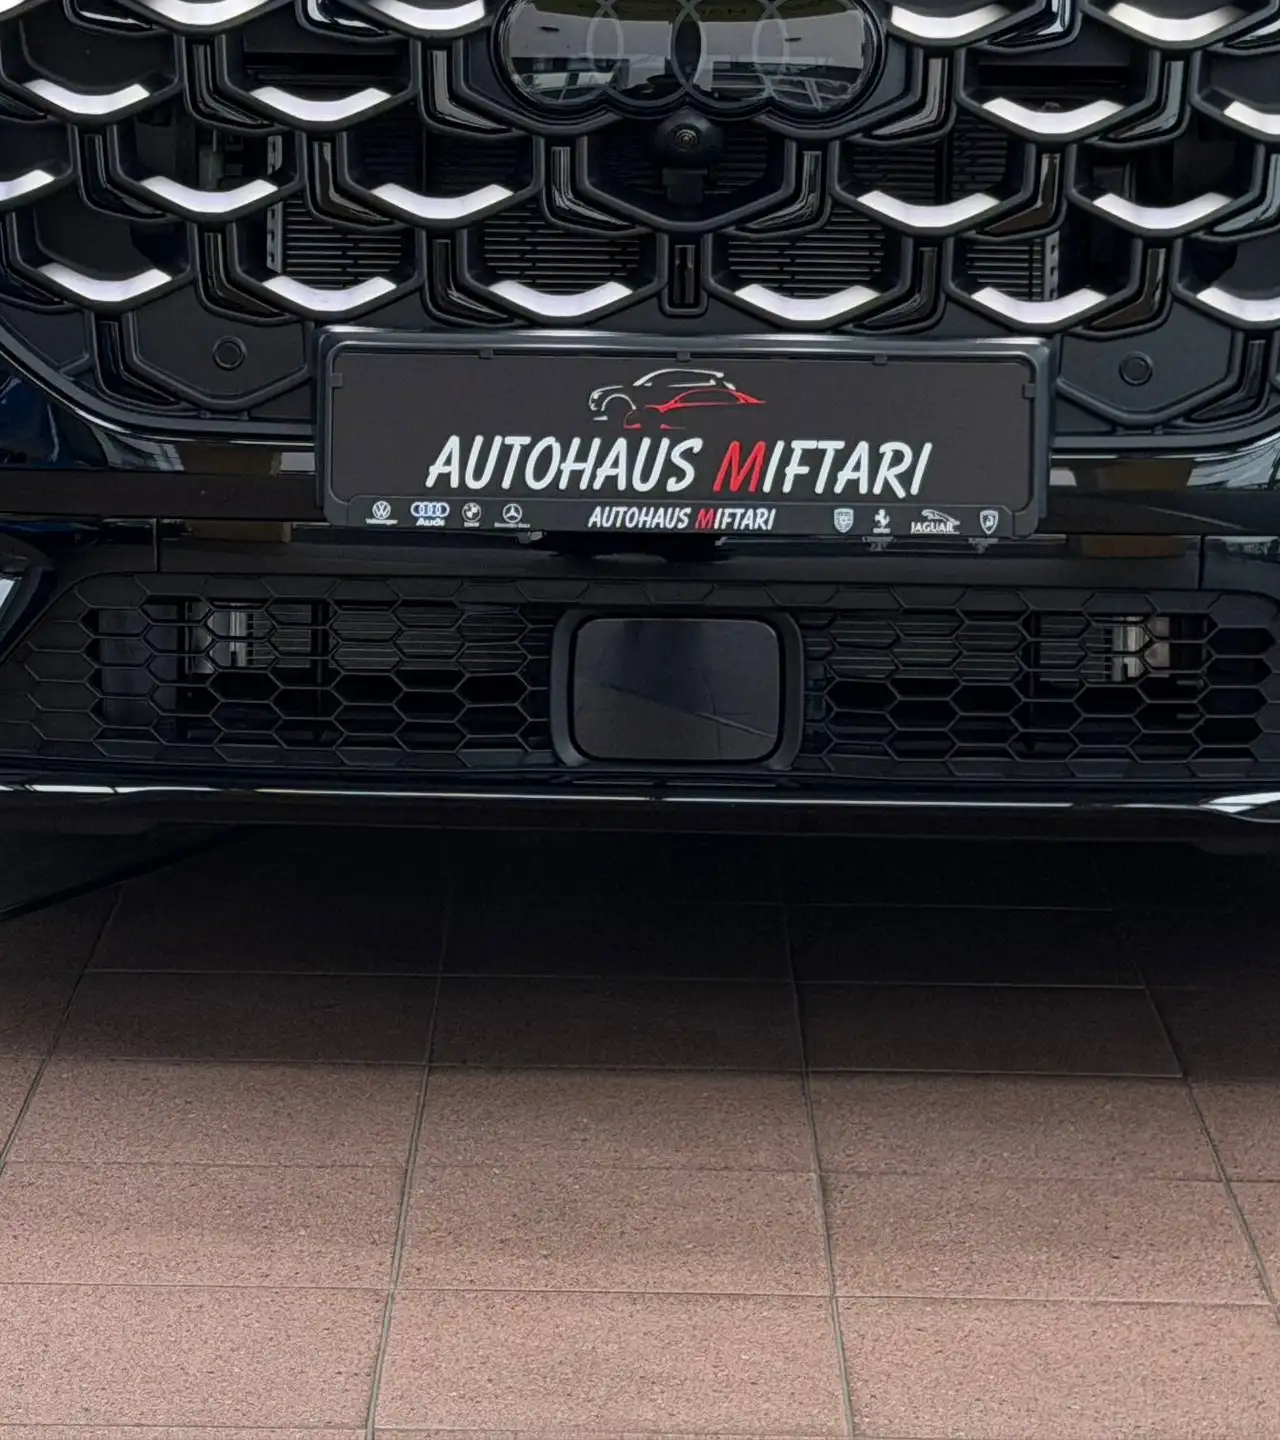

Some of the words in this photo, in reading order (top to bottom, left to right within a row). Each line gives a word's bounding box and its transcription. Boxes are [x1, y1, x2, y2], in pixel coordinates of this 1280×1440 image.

[425, 434, 703, 493] AUTOHAUS
[712, 440, 933, 499] MIFTARI
[416, 518, 445, 527] Audi
[587, 506, 692, 529] AUTOHAUS
[695, 508, 777, 531] MIFTARI
[910, 521, 955, 533] JAGUAR
